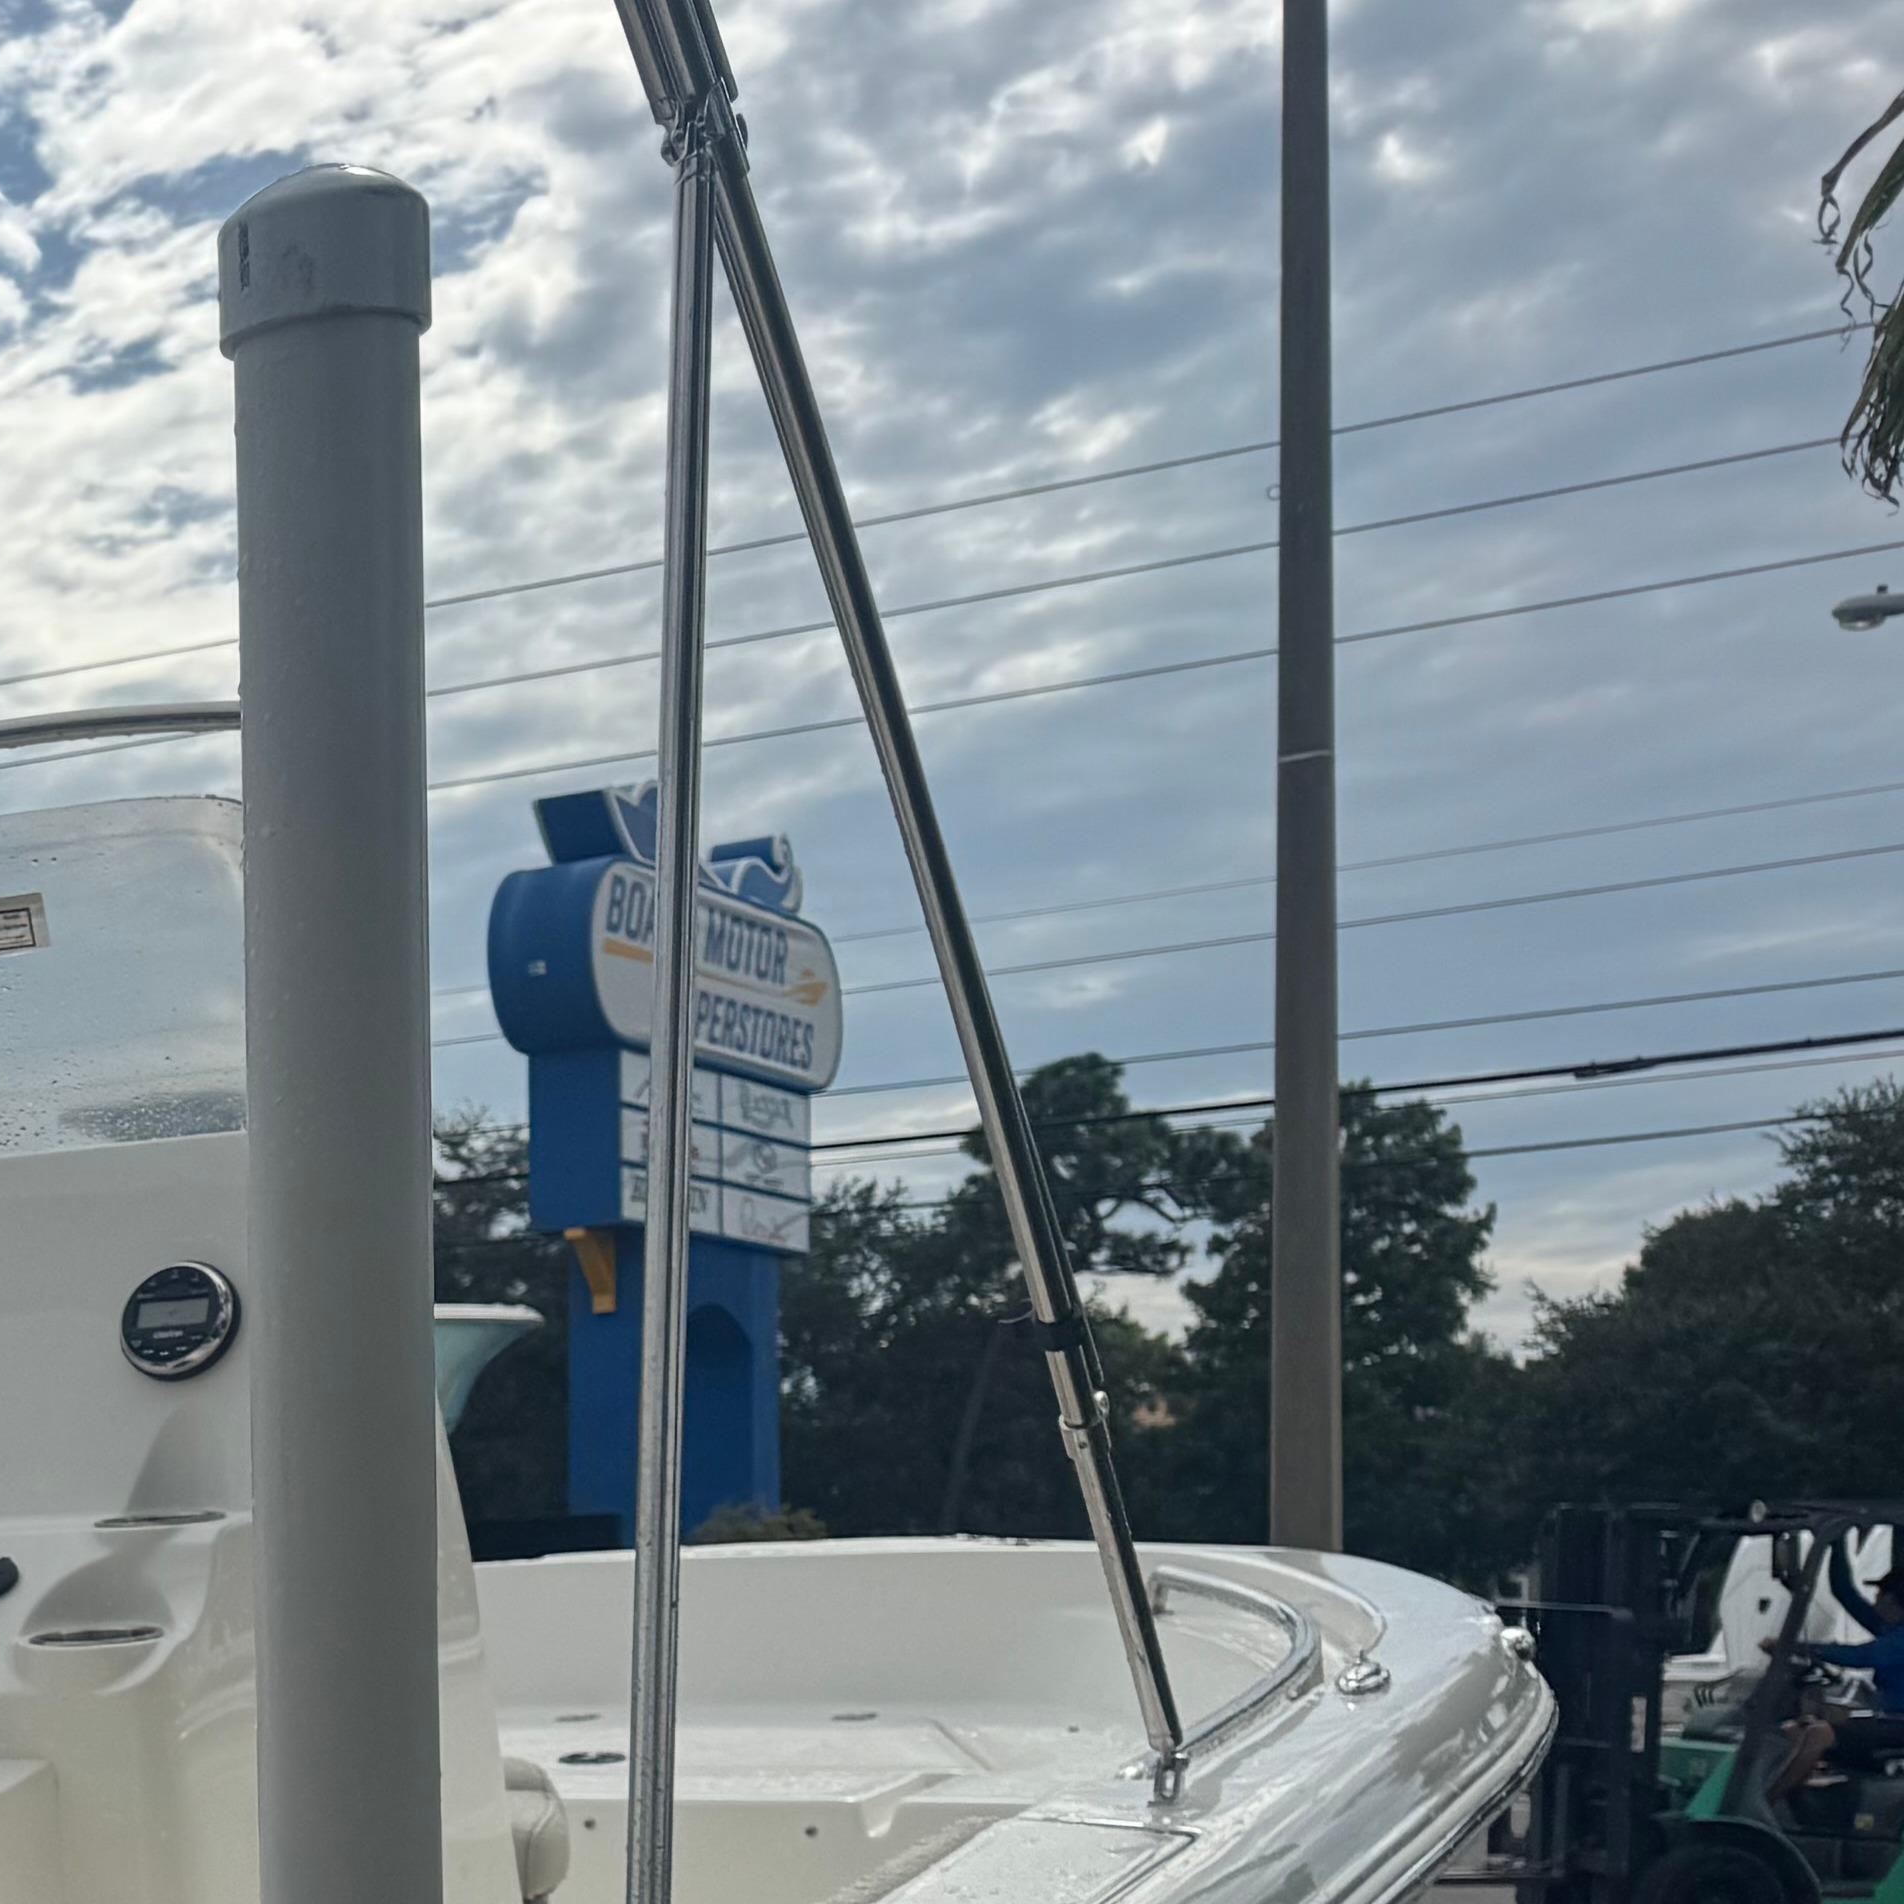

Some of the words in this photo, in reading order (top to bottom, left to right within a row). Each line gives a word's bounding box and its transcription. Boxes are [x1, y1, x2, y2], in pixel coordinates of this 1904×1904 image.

[605, 873, 655, 944] BOA
[703, 907, 789, 986] MOTOR
[694, 990, 815, 1071] PERSTORES
